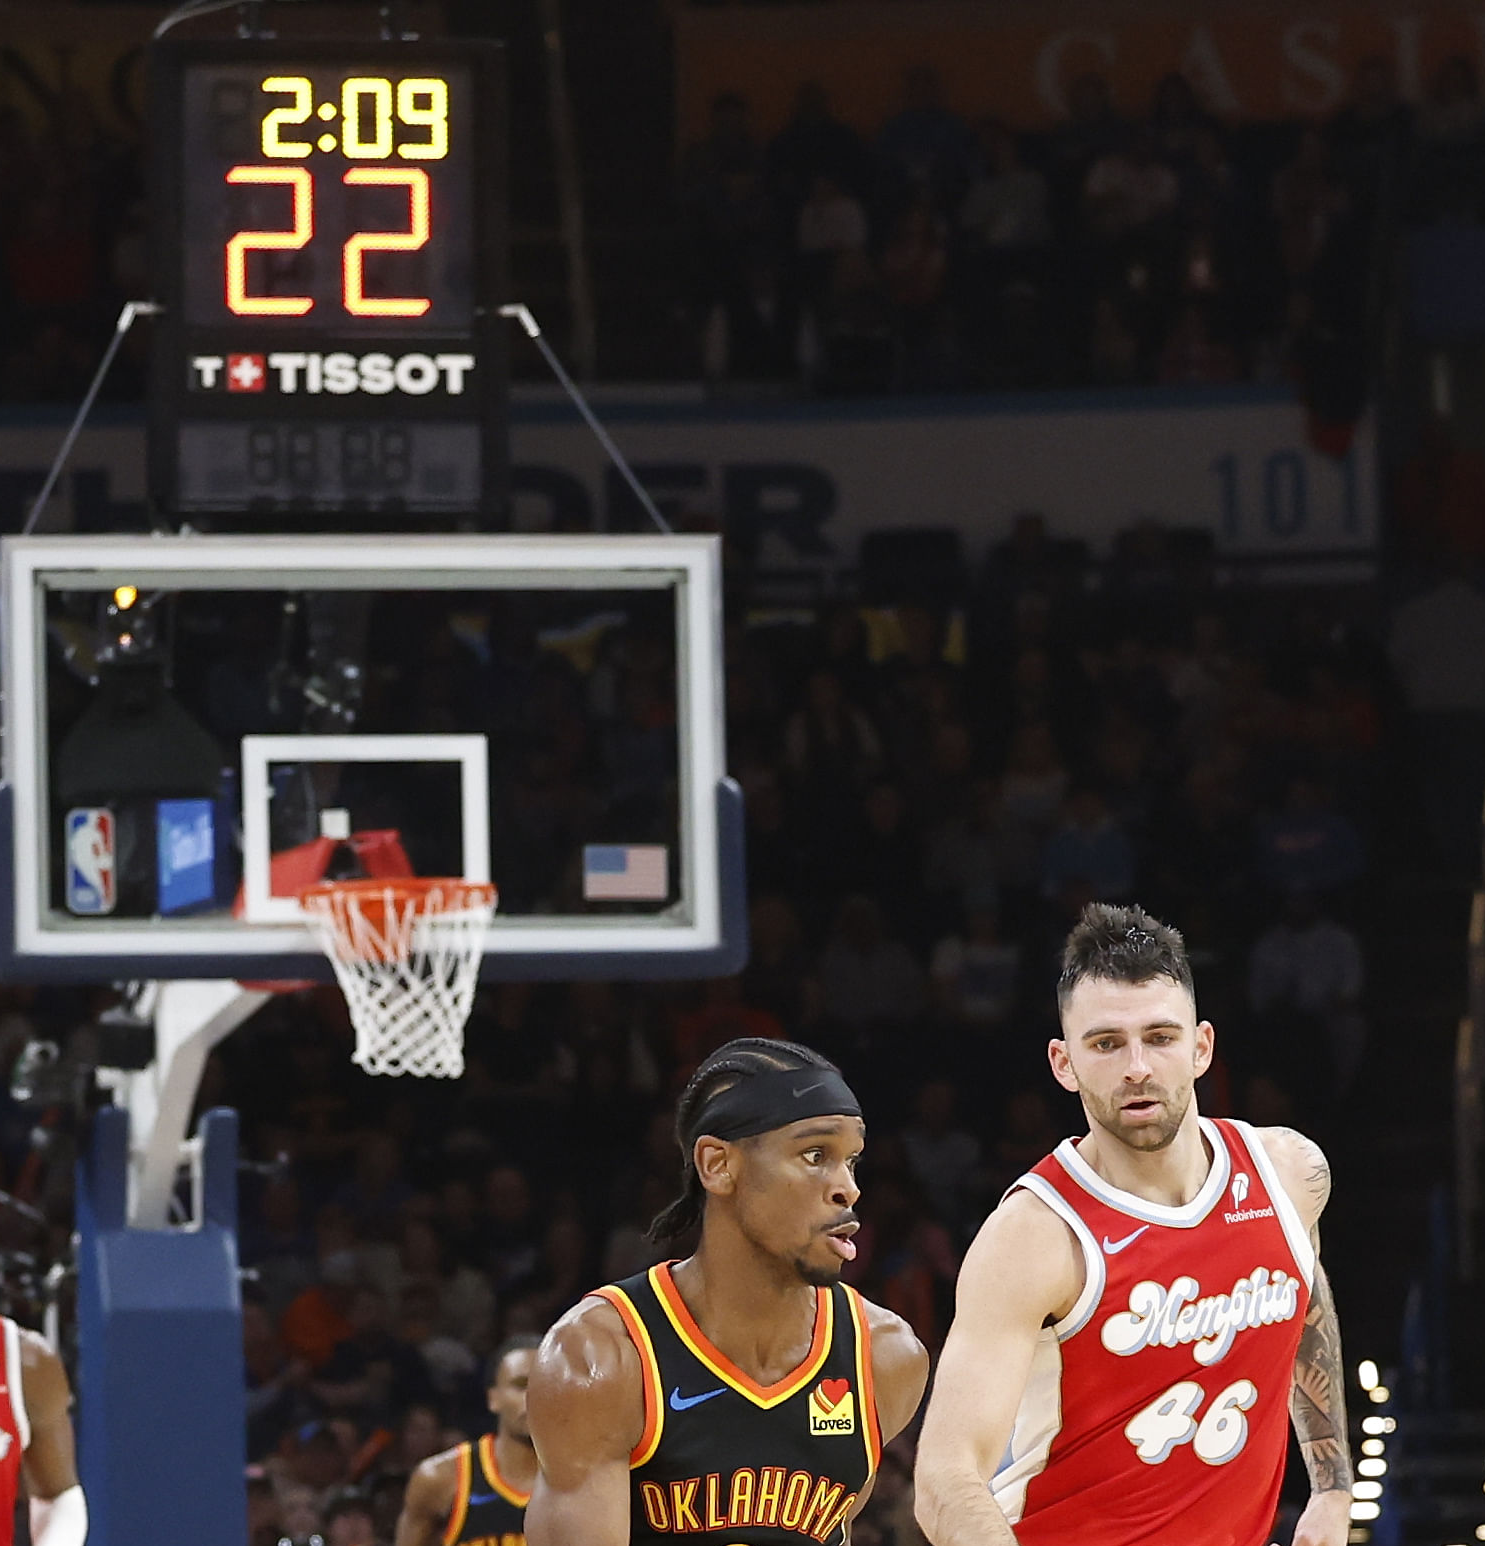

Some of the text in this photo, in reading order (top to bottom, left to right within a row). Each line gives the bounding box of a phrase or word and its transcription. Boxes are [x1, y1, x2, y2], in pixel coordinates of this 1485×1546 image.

[261, 76, 449, 160] 2:09
[224, 165, 432, 317] 22
[268, 353, 476, 395] TISSOT
[1207, 446, 1360, 540] 101
[1224, 1206, 1275, 1224] Robinhood
[1101, 1266, 1300, 1366] Memphis
[1124, 1379, 1259, 1465] 46
